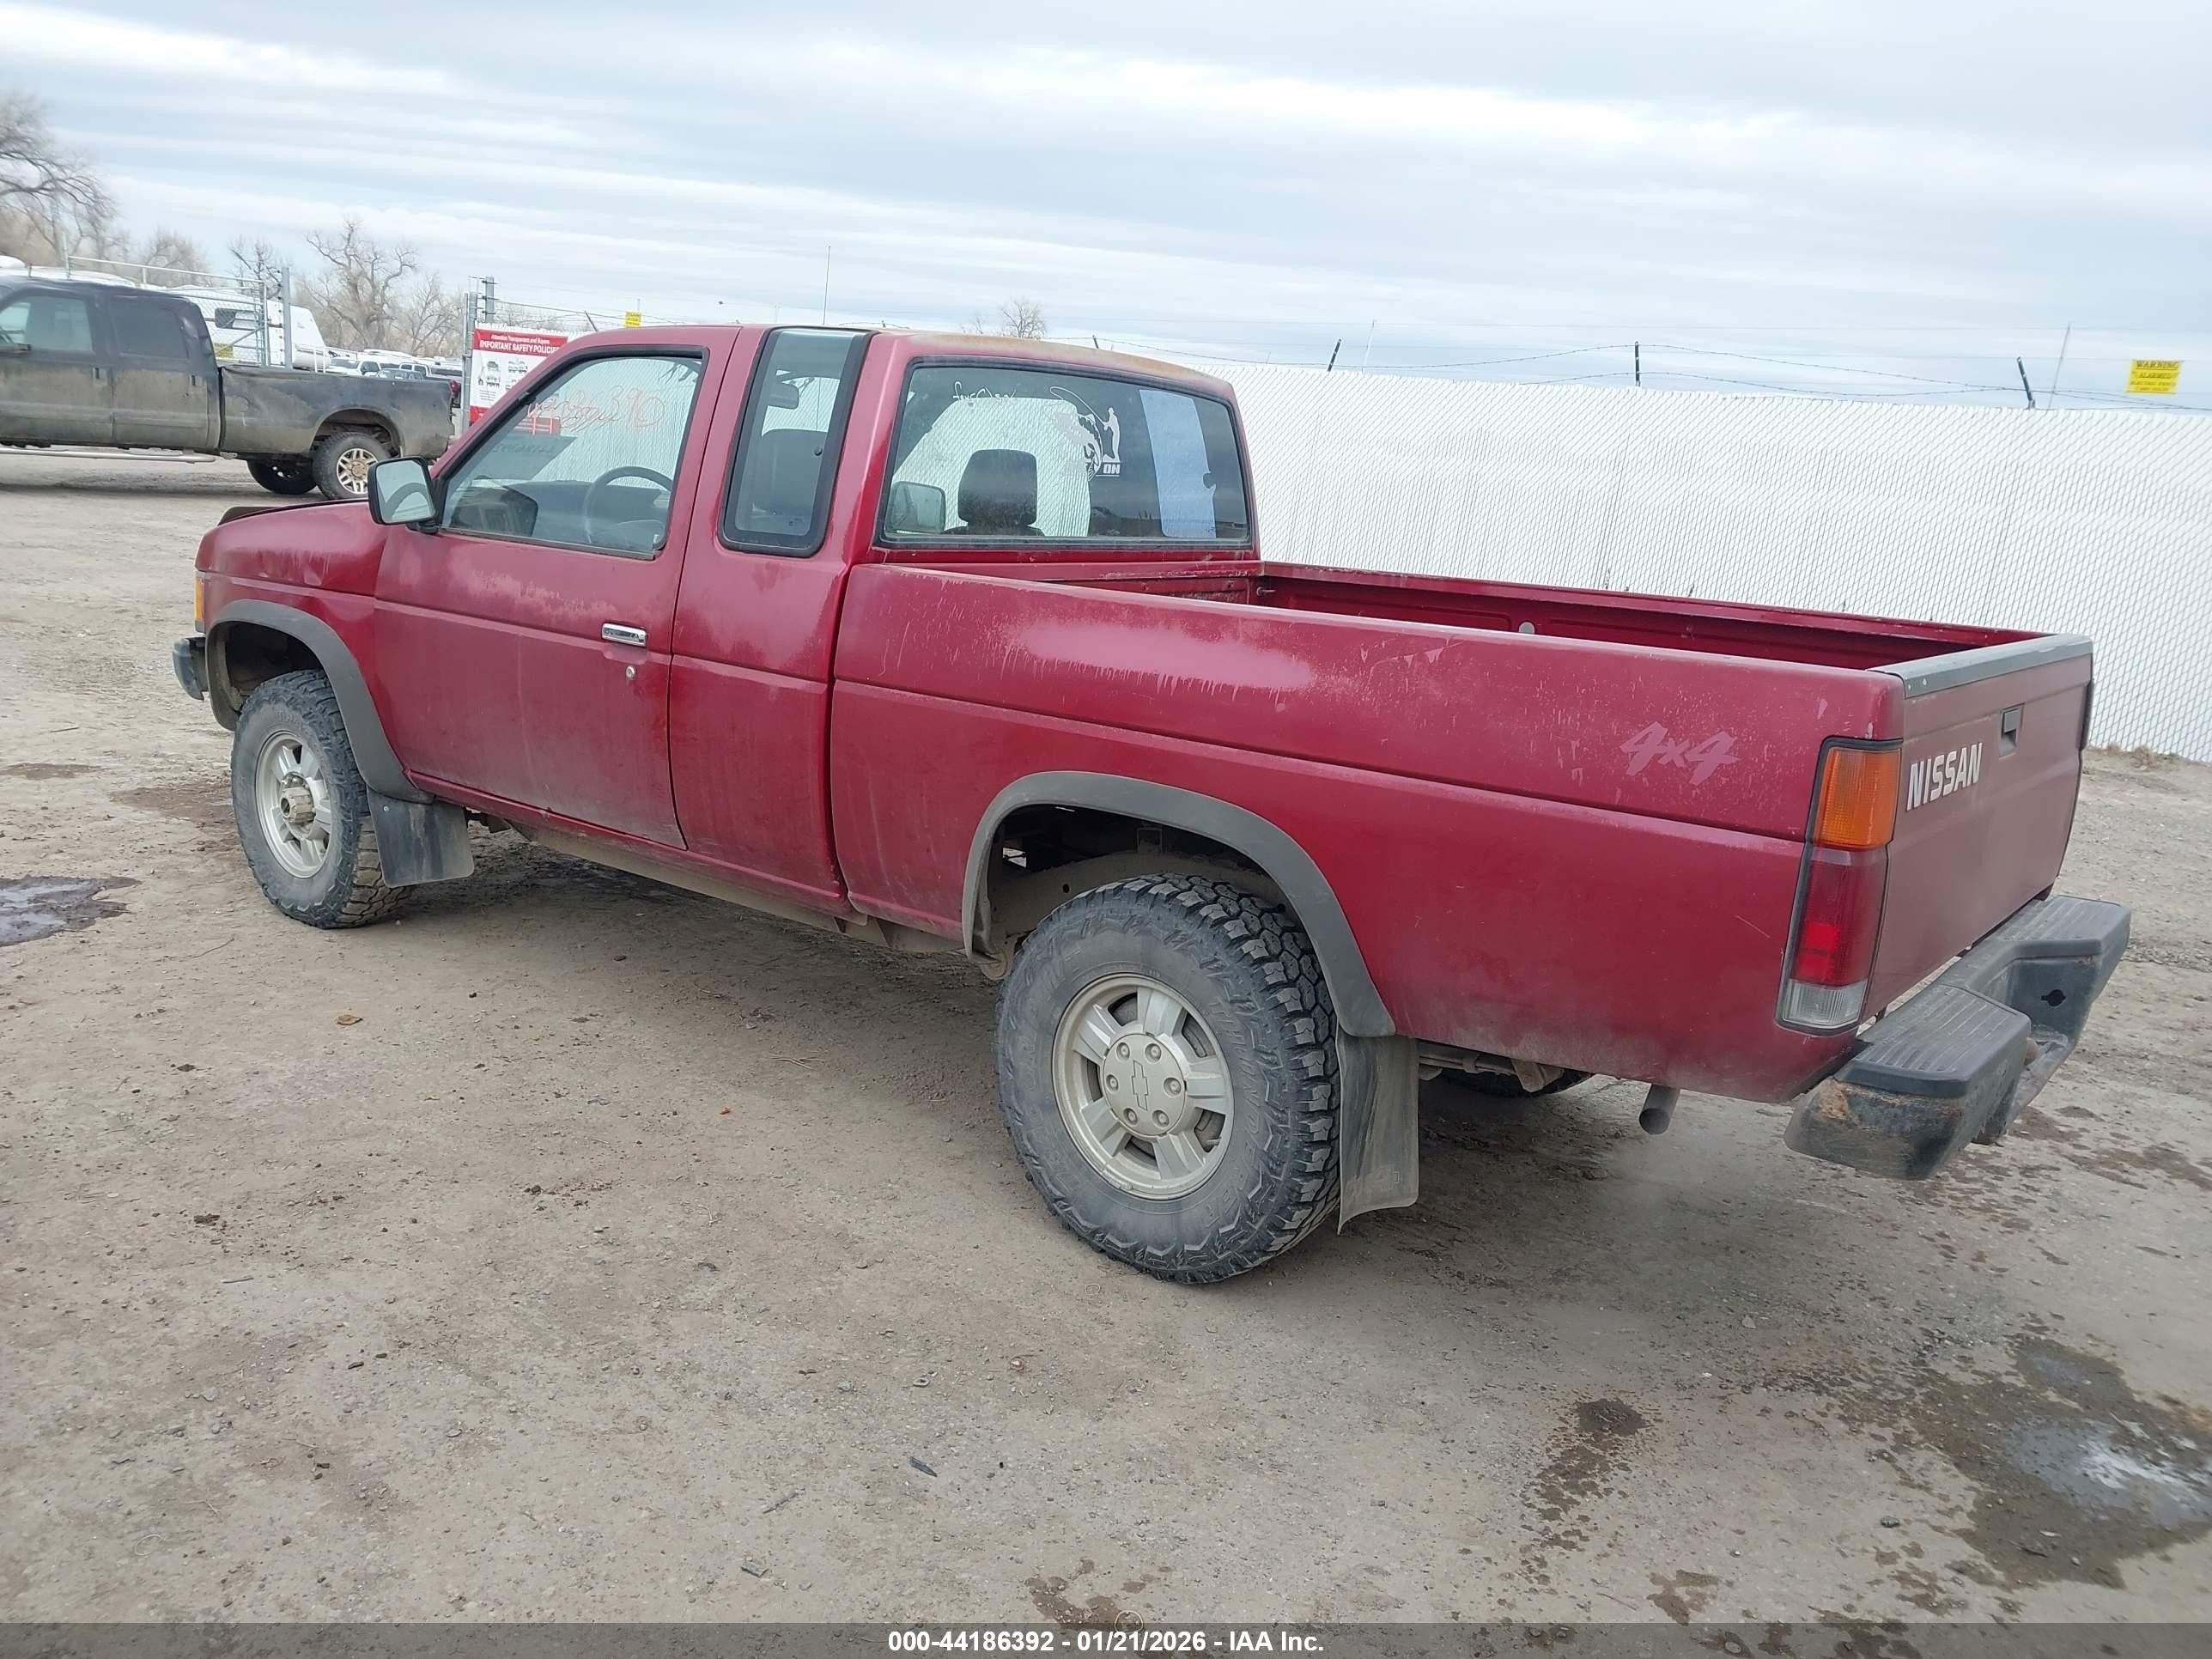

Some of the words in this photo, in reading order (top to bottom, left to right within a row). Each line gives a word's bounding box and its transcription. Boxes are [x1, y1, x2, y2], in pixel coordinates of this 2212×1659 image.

[479, 340, 512, 350] IMPORTANT
[512, 343, 533, 352] SAFETY
[1620, 721, 1738, 785] 4x4
[1906, 742, 1983, 811] NISSAN
